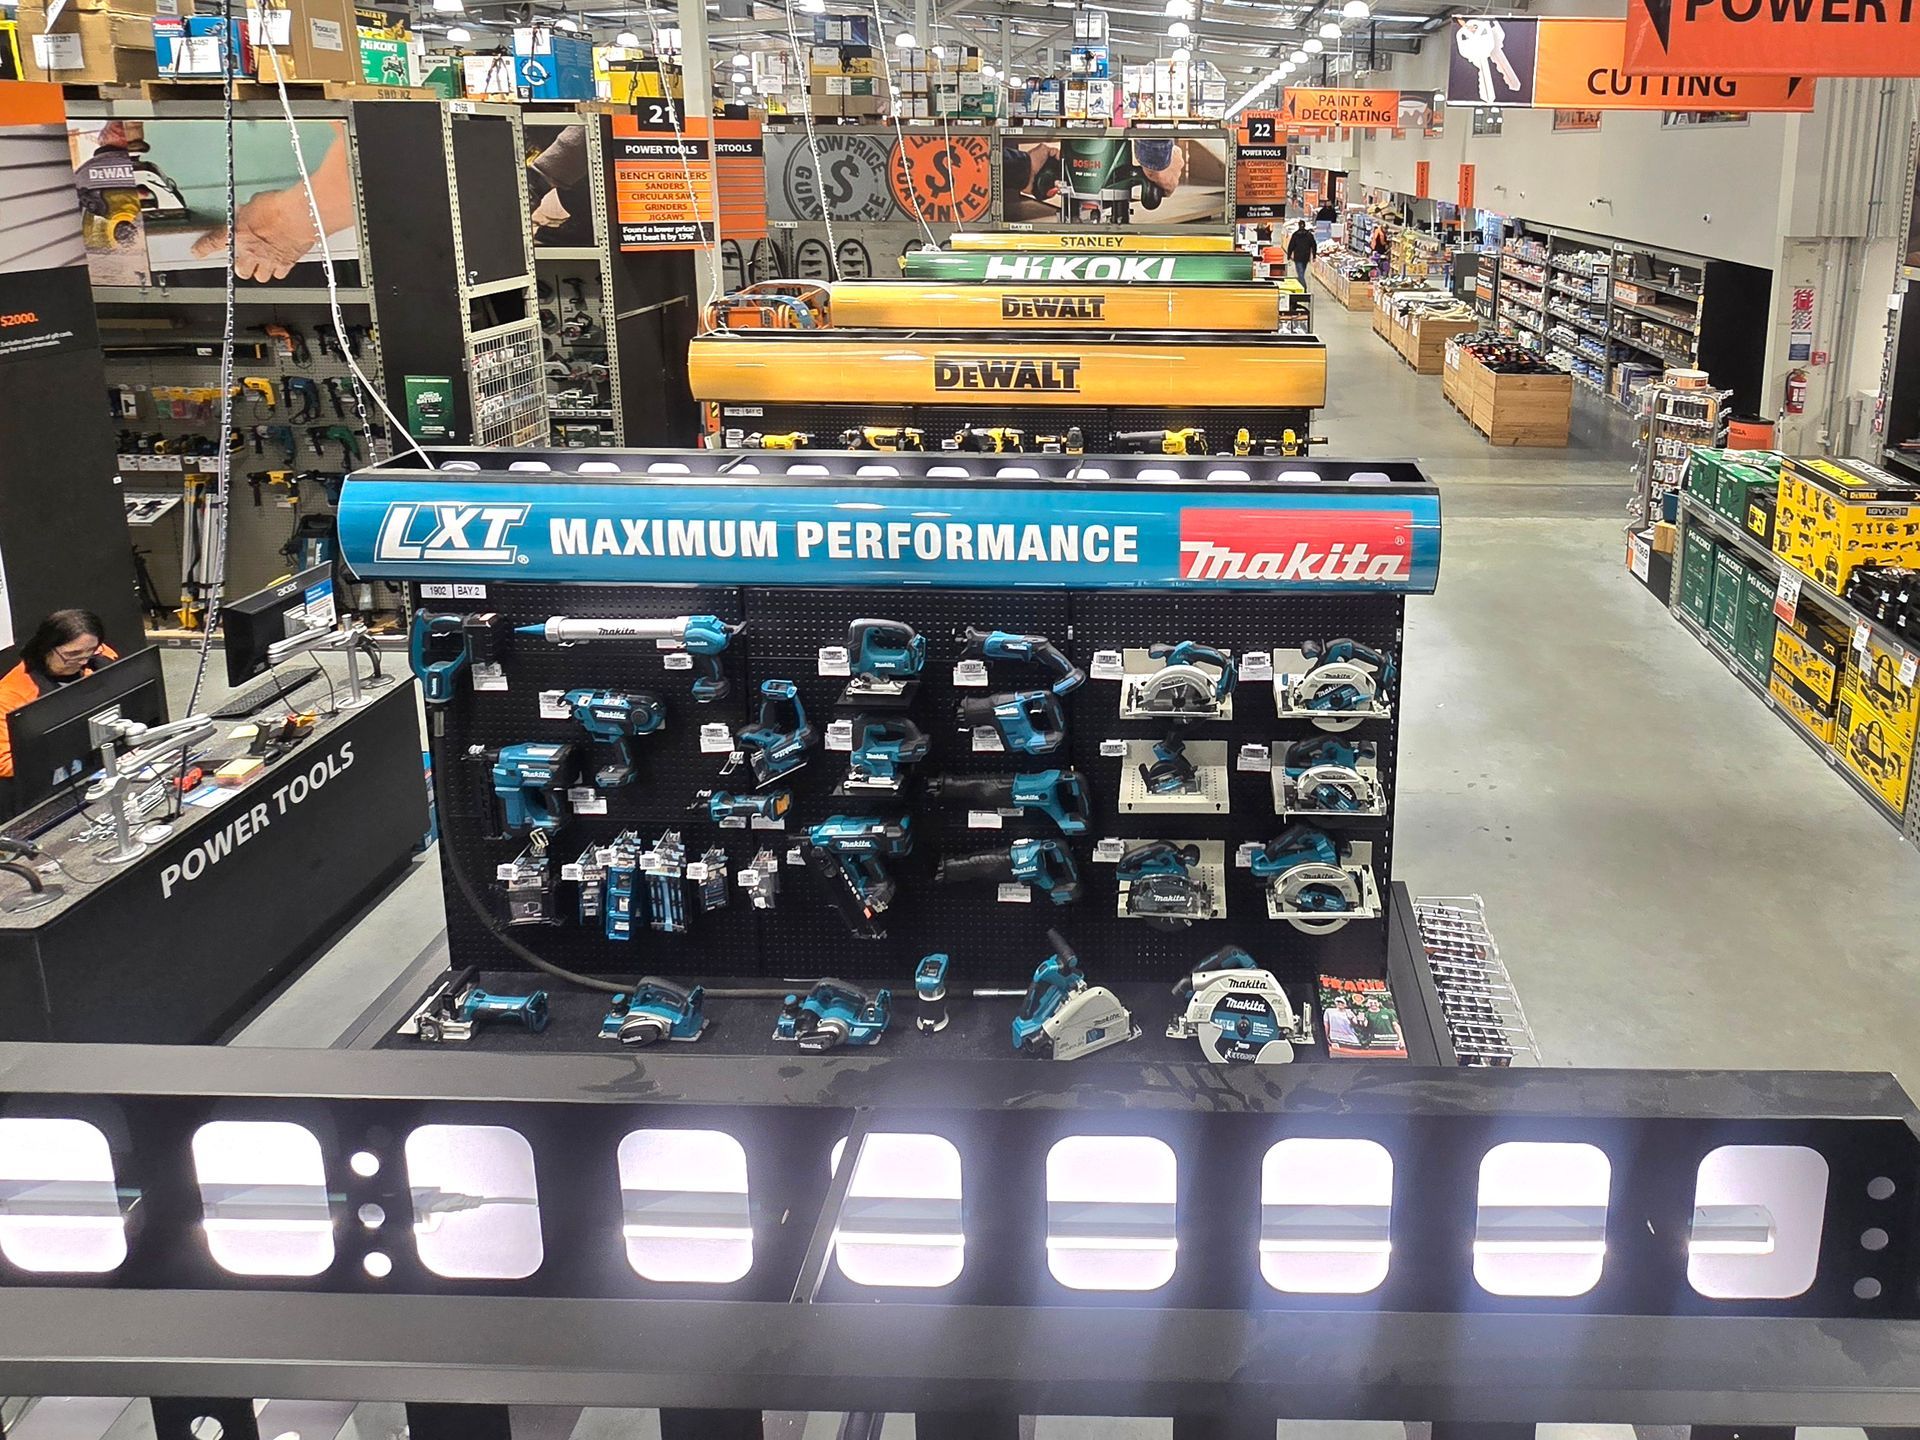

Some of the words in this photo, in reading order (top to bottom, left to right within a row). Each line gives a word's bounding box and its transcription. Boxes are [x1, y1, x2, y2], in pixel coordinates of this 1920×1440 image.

[1318, 95, 1359, 106] PAINT
[1362, 95, 1373, 107] &
[648, 104, 675, 124] 21
[1301, 108, 1391, 122] DECORATING
[1254, 123, 1271, 137] 22
[625, 145, 663, 154] POWER
[665, 145, 698, 155] TOOLS
[620, 172, 655, 180] BENCH
[657, 172, 707, 180] GRINDERS
[631, 193, 674, 201] CIRCULAR
[644, 203, 688, 211] GRINDERS
[648, 213, 685, 221] JIGSAWS
[622, 226, 647, 234] Found
[1060, 236, 1124, 247] STANLEY
[983, 256, 1177, 281] HiKOKI
[1002, 296, 1104, 319] DEWALT
[0, 313, 39, 327] $2000.
[935, 358, 1080, 391] DEWALT
[375, 502, 532, 564] LXT
[1688, 529, 1712, 552] HiKOKI
[549, 518, 778, 558] MAXIMUM
[797, 521, 1138, 564] PERFORMANCE
[1717, 551, 1743, 575] HiKOKI
[276, 581, 298, 597] acer
[429, 586, 447, 596] 1902
[457, 586, 474, 596] BAY
[474, 587, 480, 596] 2
[1747, 573, 1775, 600] HiKOKI
[160, 802, 271, 899] POWER
[272, 741, 355, 816] TOOLS
[1319, 977, 1386, 993] TRADIE
